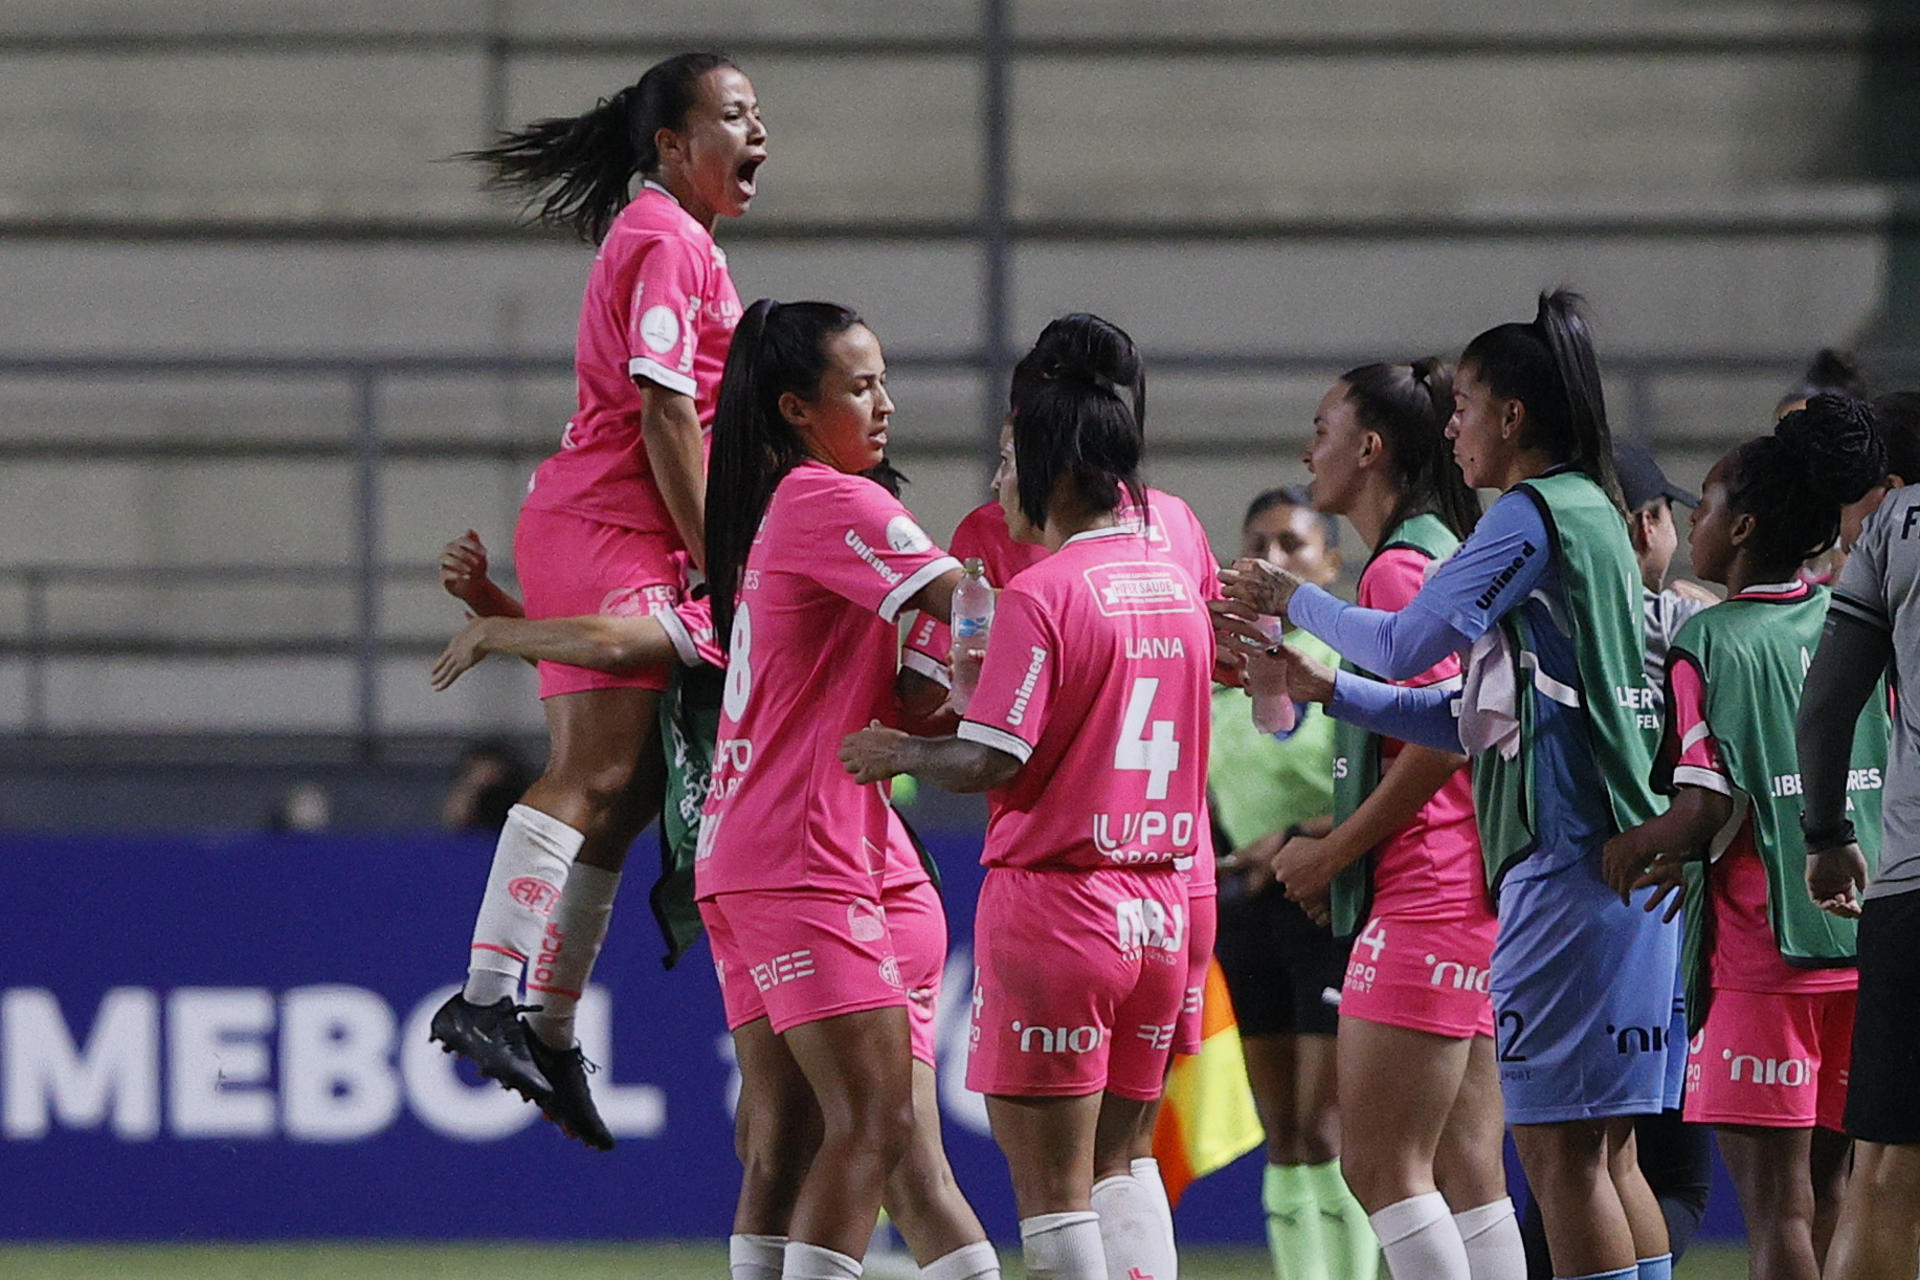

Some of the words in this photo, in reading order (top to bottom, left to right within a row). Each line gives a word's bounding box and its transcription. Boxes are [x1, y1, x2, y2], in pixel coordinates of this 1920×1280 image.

[844, 529, 903, 585] Unimed
[1476, 540, 1537, 610] Unimed
[723, 600, 752, 722] 8
[1124, 636, 1185, 659] LUANA
[1006, 646, 1048, 726] Unimed
[1113, 677, 1181, 800] 4
[1092, 810, 1194, 853] LUPO
[1352, 916, 1386, 962] 14
[2, 984, 668, 1142] MEBOL
